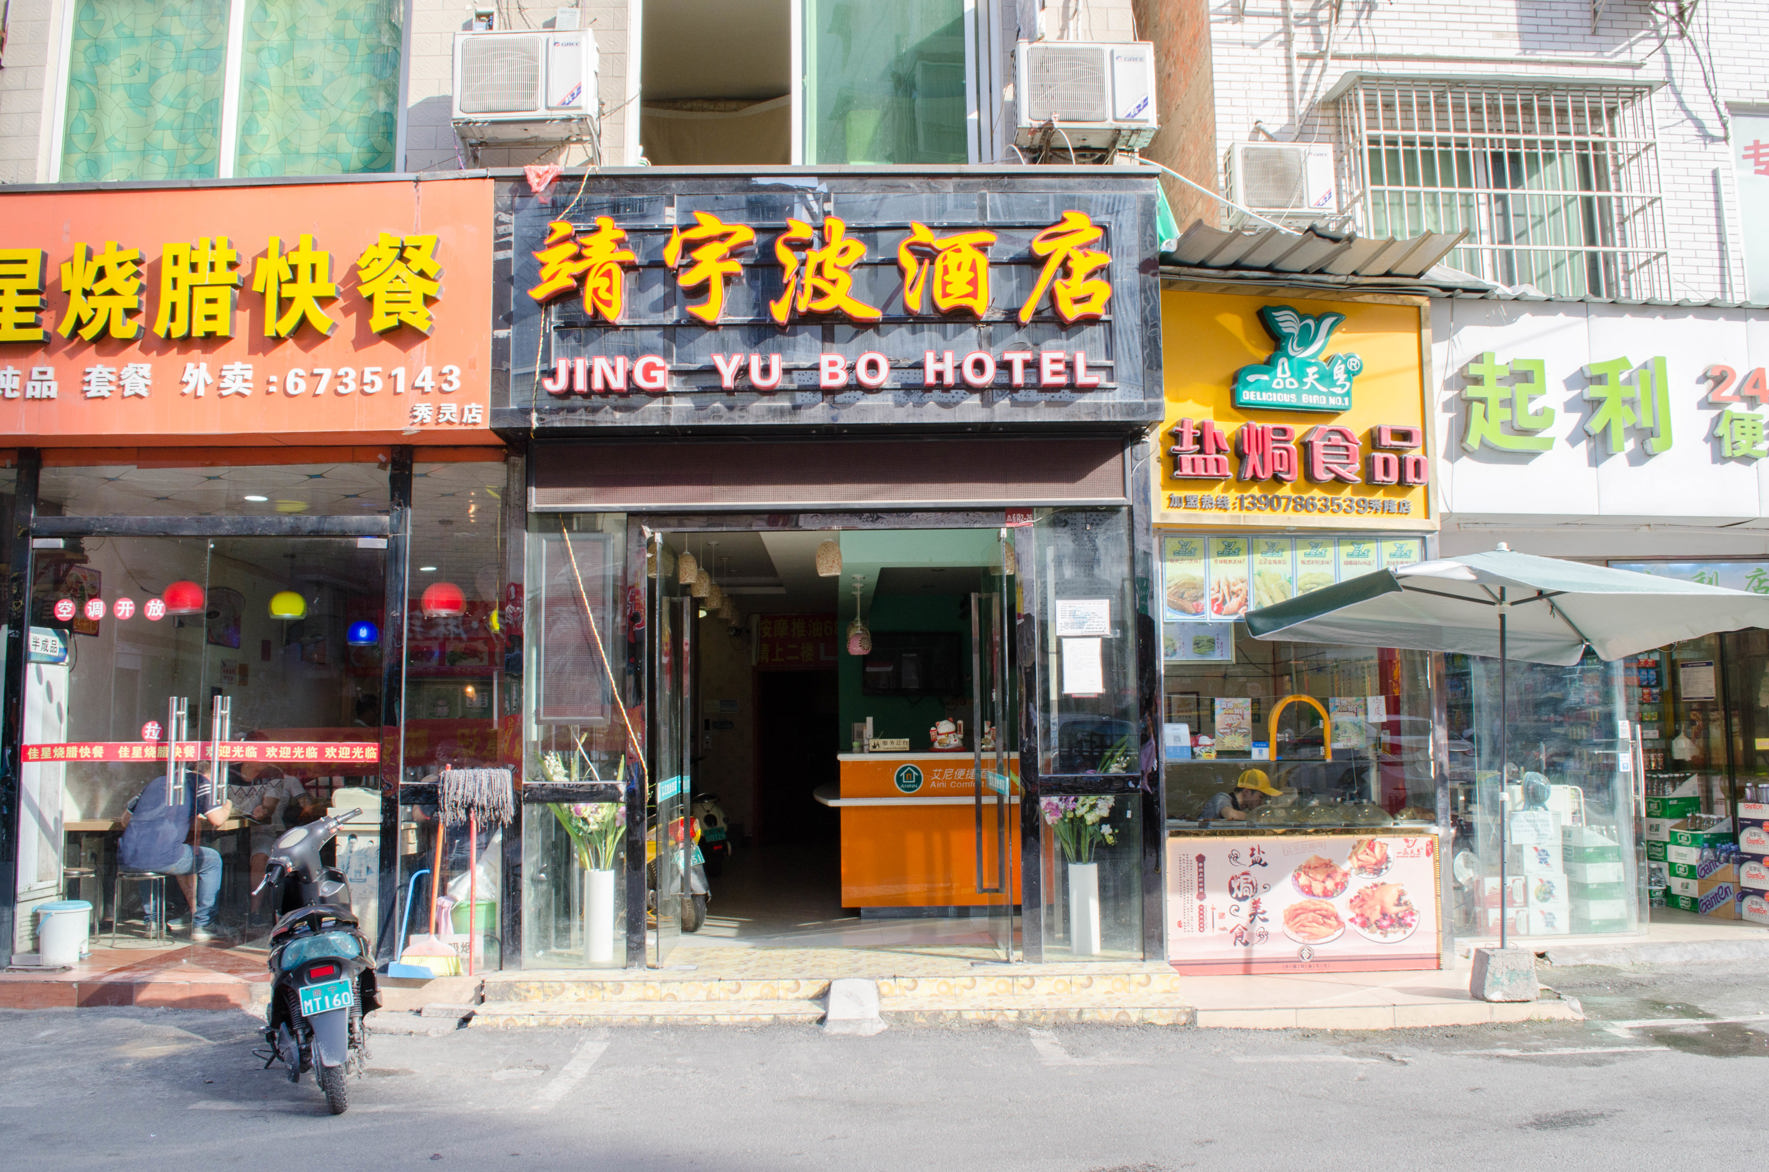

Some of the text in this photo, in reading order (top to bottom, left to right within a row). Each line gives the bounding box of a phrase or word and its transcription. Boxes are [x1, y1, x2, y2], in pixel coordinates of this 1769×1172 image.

[527, 210, 1113, 326] 靖宇波酒店
[0, 233, 443, 343] 星烧腊快餐
[83, 363, 152, 398] 套餐
[542, 350, 1101, 395] JING YU BO HOTEL
[1243, 390, 1297, 403] DELICIOUS
[1328, 396, 1349, 406] NO.1
[411, 403, 483, 423] 秀灵店
[1168, 418, 1428, 486] 盐焗食品
[57, 600, 165, 618] 空调开放
[144, 723, 161, 740] 拉
[27, 746, 104, 760] 佳星烧腊快餐
[265, 745, 318, 759] 欢迎光临
[324, 745, 377, 760] 欢迎光临
[1698, 885, 1732, 914] Ganten
[304, 992, 351, 1014] MT160
